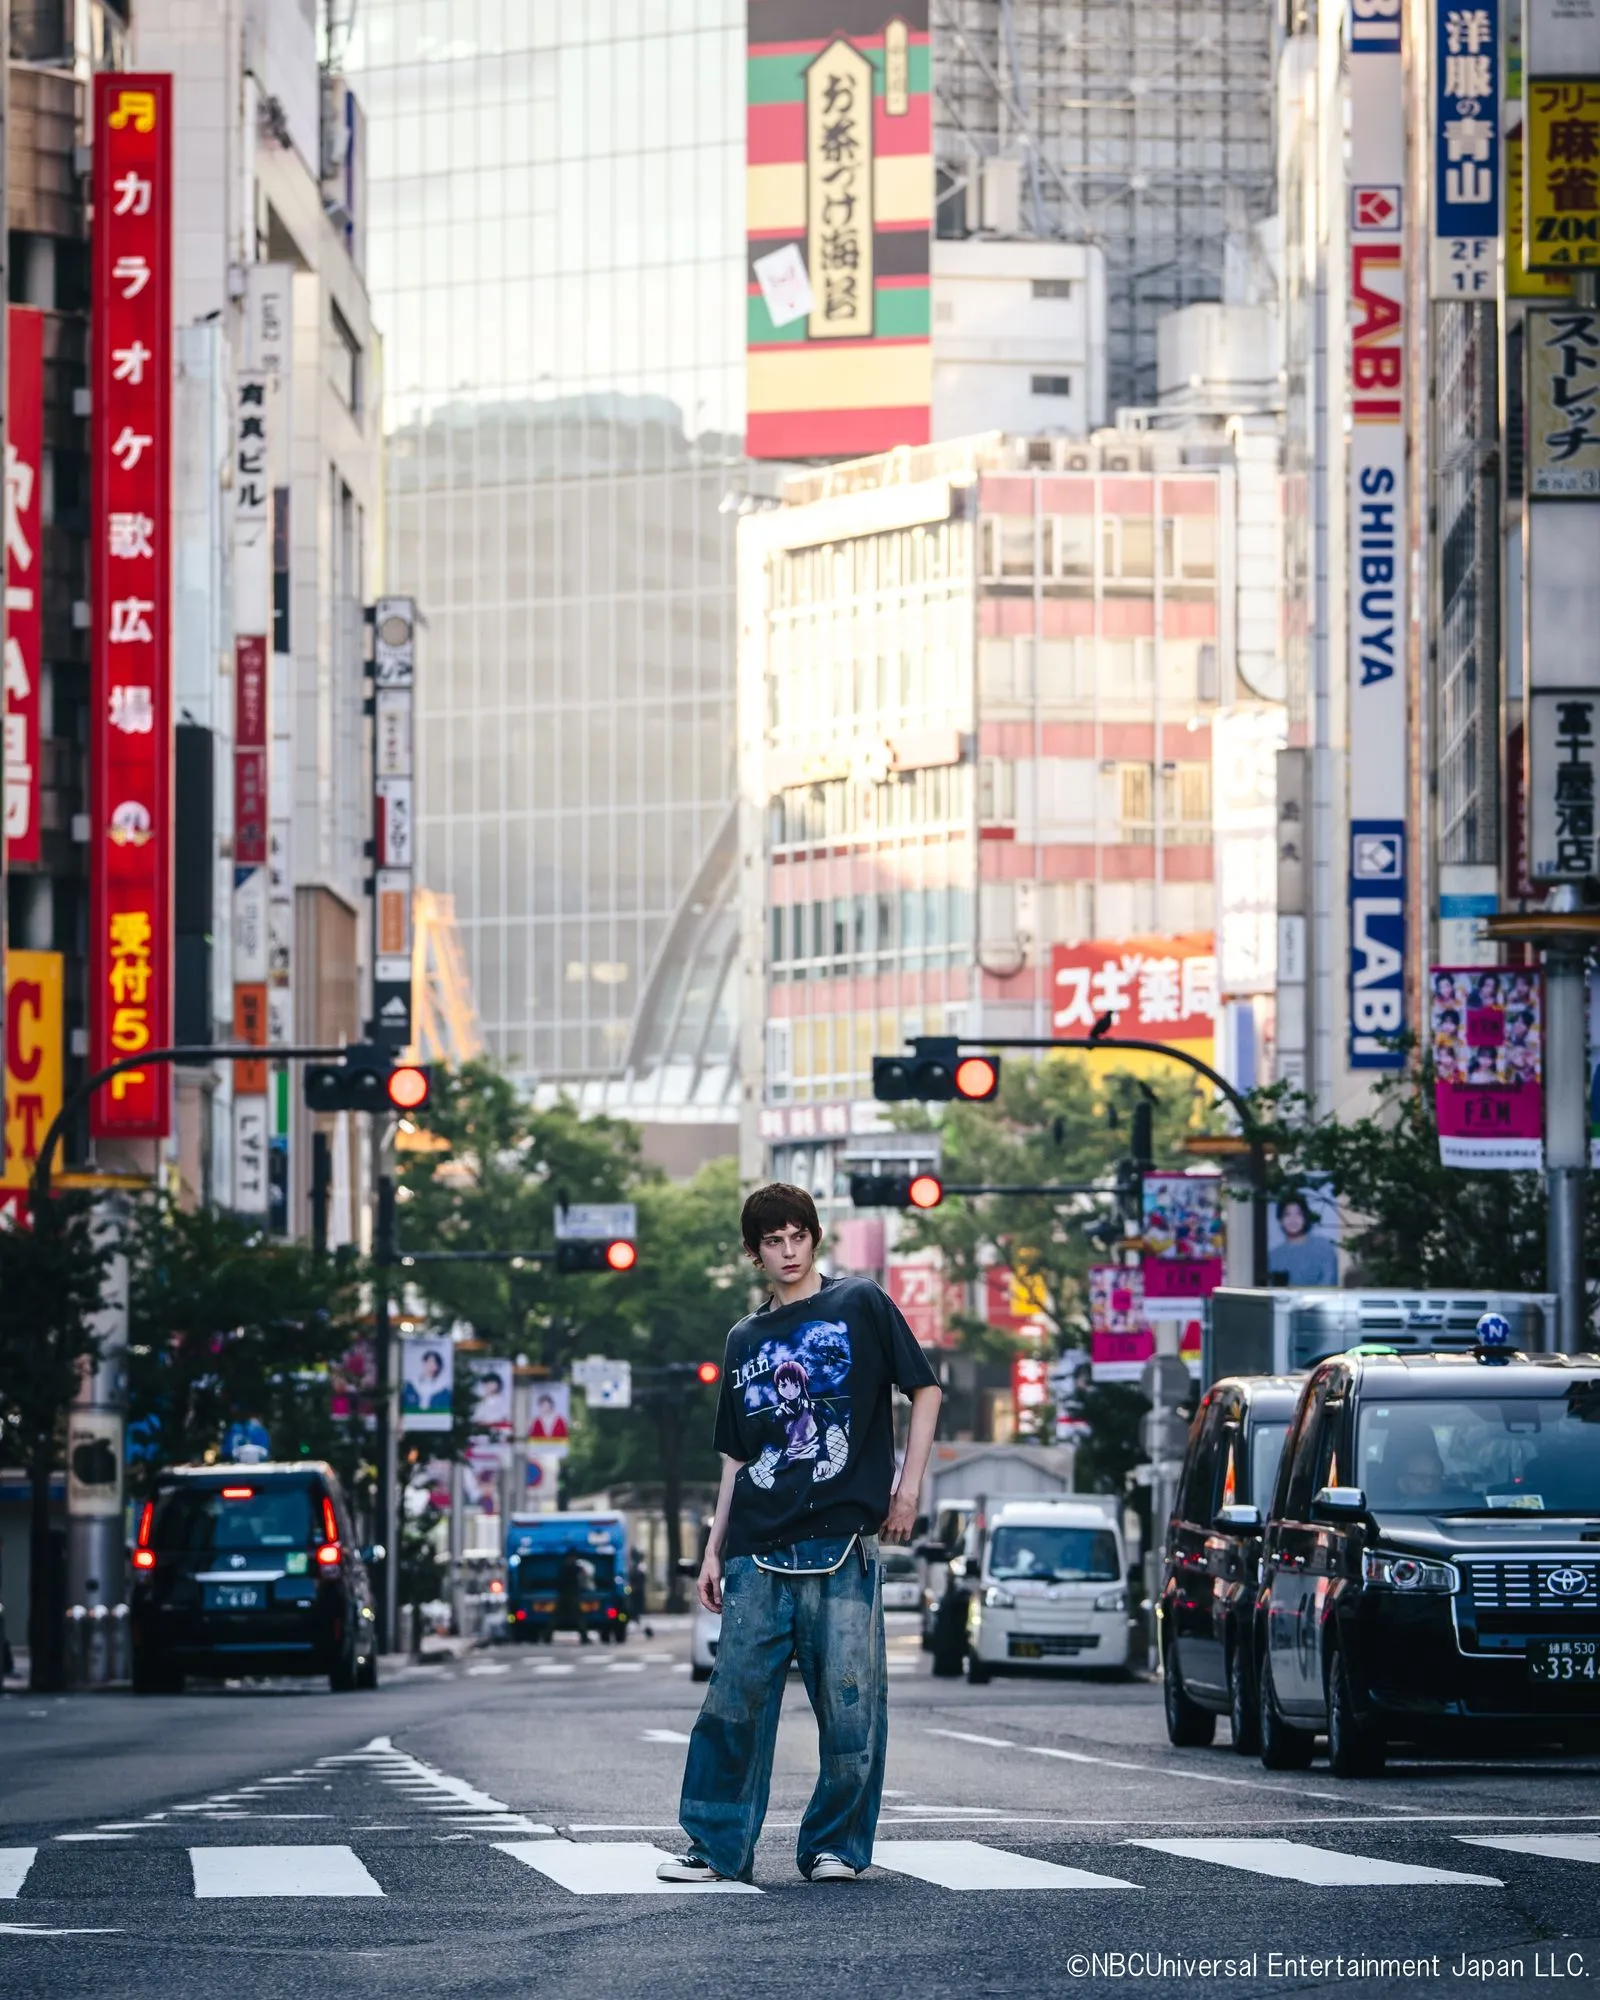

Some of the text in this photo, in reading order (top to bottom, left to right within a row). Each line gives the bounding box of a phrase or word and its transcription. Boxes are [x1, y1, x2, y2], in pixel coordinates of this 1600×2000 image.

[1443, 10, 1494, 205] 洋服の青山
[1451, 240, 1490, 260] 2F
[1452, 272, 1490, 291] 1F
[1352, 245, 1402, 423] LABI
[1545, 315, 1600, 462] ストレッチ
[108, 171, 155, 736] カラオケ歌広場
[1360, 467, 1394, 686] SHIBUYA
[1555, 701, 1594, 872] 富士屋酒店
[1055, 953, 1219, 1027] スギ薬局
[1352, 898, 1402, 1056] LABI
[731, 1358, 770, 1389] lain
[1489, 1325, 1503, 1338] N
[1547, 1657, 1600, 1679] 33-4
[1574, 1642, 1596, 1654] 530
